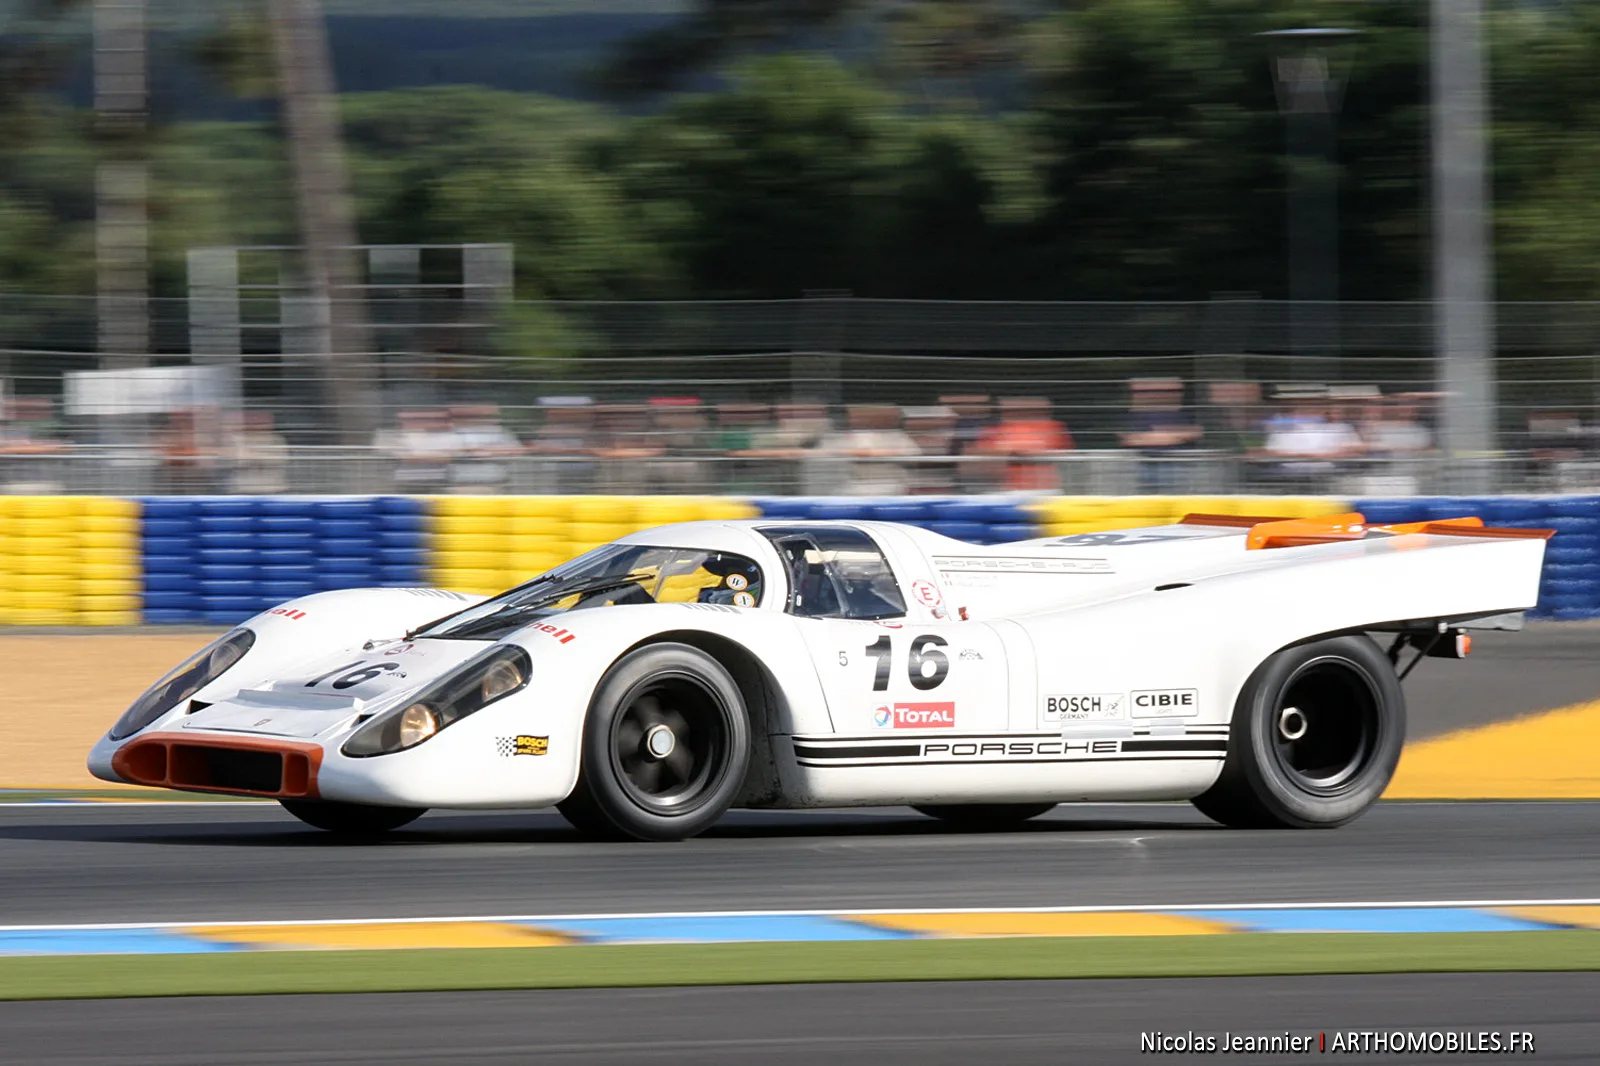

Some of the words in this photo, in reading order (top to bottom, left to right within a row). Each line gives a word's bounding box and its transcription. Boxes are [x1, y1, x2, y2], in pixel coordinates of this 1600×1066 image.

[920, 587, 933, 600] E
[838, 651, 848, 667] 5
[865, 634, 949, 692] 16
[303, 660, 400, 689] 16
[1047, 696, 1101, 713] BOSCH
[1135, 693, 1193, 707] CIBIE
[895, 707, 953, 724] TOTAL
[517, 736, 548, 748] BOSCH
[924, 740, 1117, 756] PORSCHE
